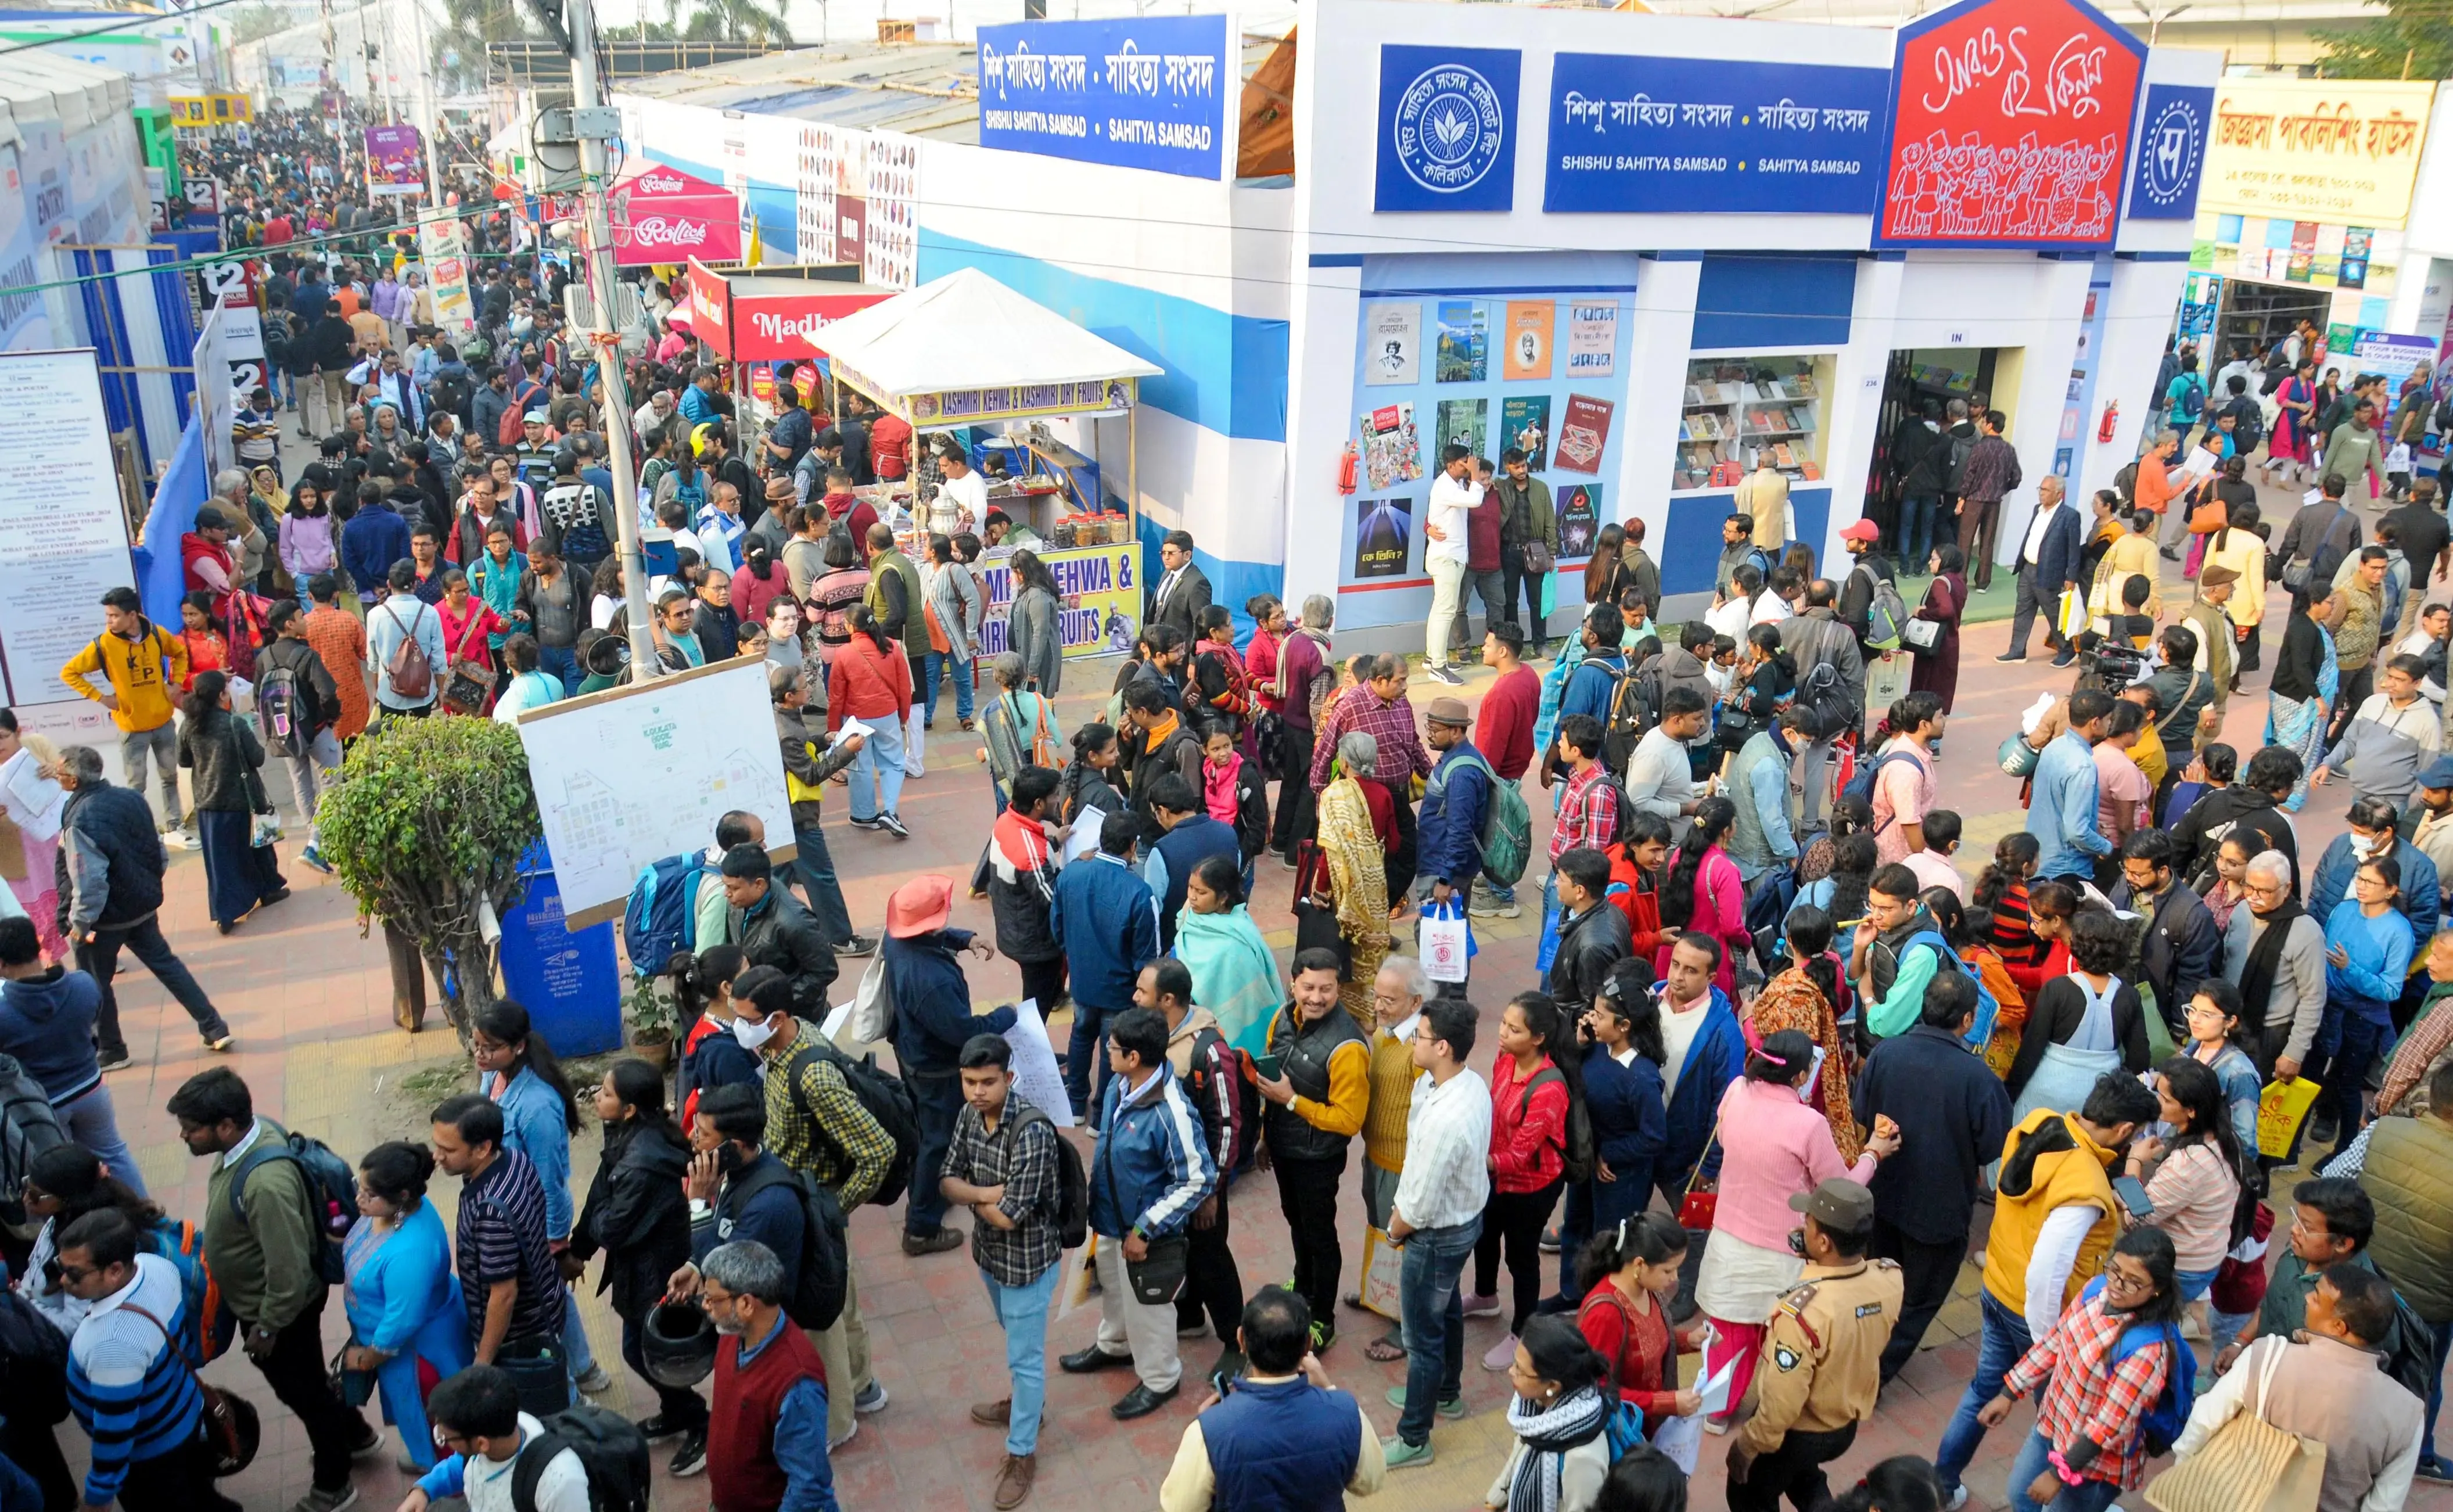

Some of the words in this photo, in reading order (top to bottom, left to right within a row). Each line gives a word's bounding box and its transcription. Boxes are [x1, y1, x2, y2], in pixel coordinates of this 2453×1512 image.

[982, 42, 1007, 102] শিশু
[1006, 39, 1046, 92] সাহিত্য
[1048, 54, 1087, 93] সংসদ
[1105, 38, 1161, 97] সাহিত্য
[1165, 55, 1215, 98] সংসদ
[1563, 90, 1606, 134] শিশু
[1610, 93, 1677, 130] সাহিত্য
[1681, 103, 1734, 129] সংসদ
[1758, 97, 1819, 132] সাহিত্য
[1822, 108, 1871, 133] সংসদ
[986, 109, 1012, 131] SHISHU
[1014, 110, 1047, 134] SAHITYA
[1048, 113, 1087, 138] SAMSAD
[1109, 118, 1156, 145] SAHITYA
[1158, 121, 1211, 151] SAMSAD
[2280, 101, 2362, 157] পাবলিশিং
[2366, 110, 2418, 162] হাউস
[1562, 156, 1612, 170] SHISHU
[1616, 157, 1671, 171] SAHITYA
[1673, 158, 1727, 173] SAMSAD
[1758, 159, 1808, 173] SAHITYA
[1811, 160, 1861, 175] SAMSAD
[635, 216, 707, 247] Rollick
[201, 261, 247, 296] t2
[1951, 332, 1963, 343] IN
[942, 390, 981, 416] KASHMIRI
[983, 387, 1010, 412] KEHWA
[1012, 387, 1019, 408] &
[1021, 384, 1058, 408] KASHMIRI
[1061, 382, 1076, 405] DRY
[1078, 379, 1104, 404] FRUITS
[1865, 379, 1878, 387] 236
[1116, 552, 1134, 591] &
[1362, 553, 1375, 562] কে
[1375, 549, 1396, 561] তিনি
[1060, 606, 1100, 647] RUITS
[643, 723, 677, 738] KOLKATA
[651, 732, 673, 744] BOOK
